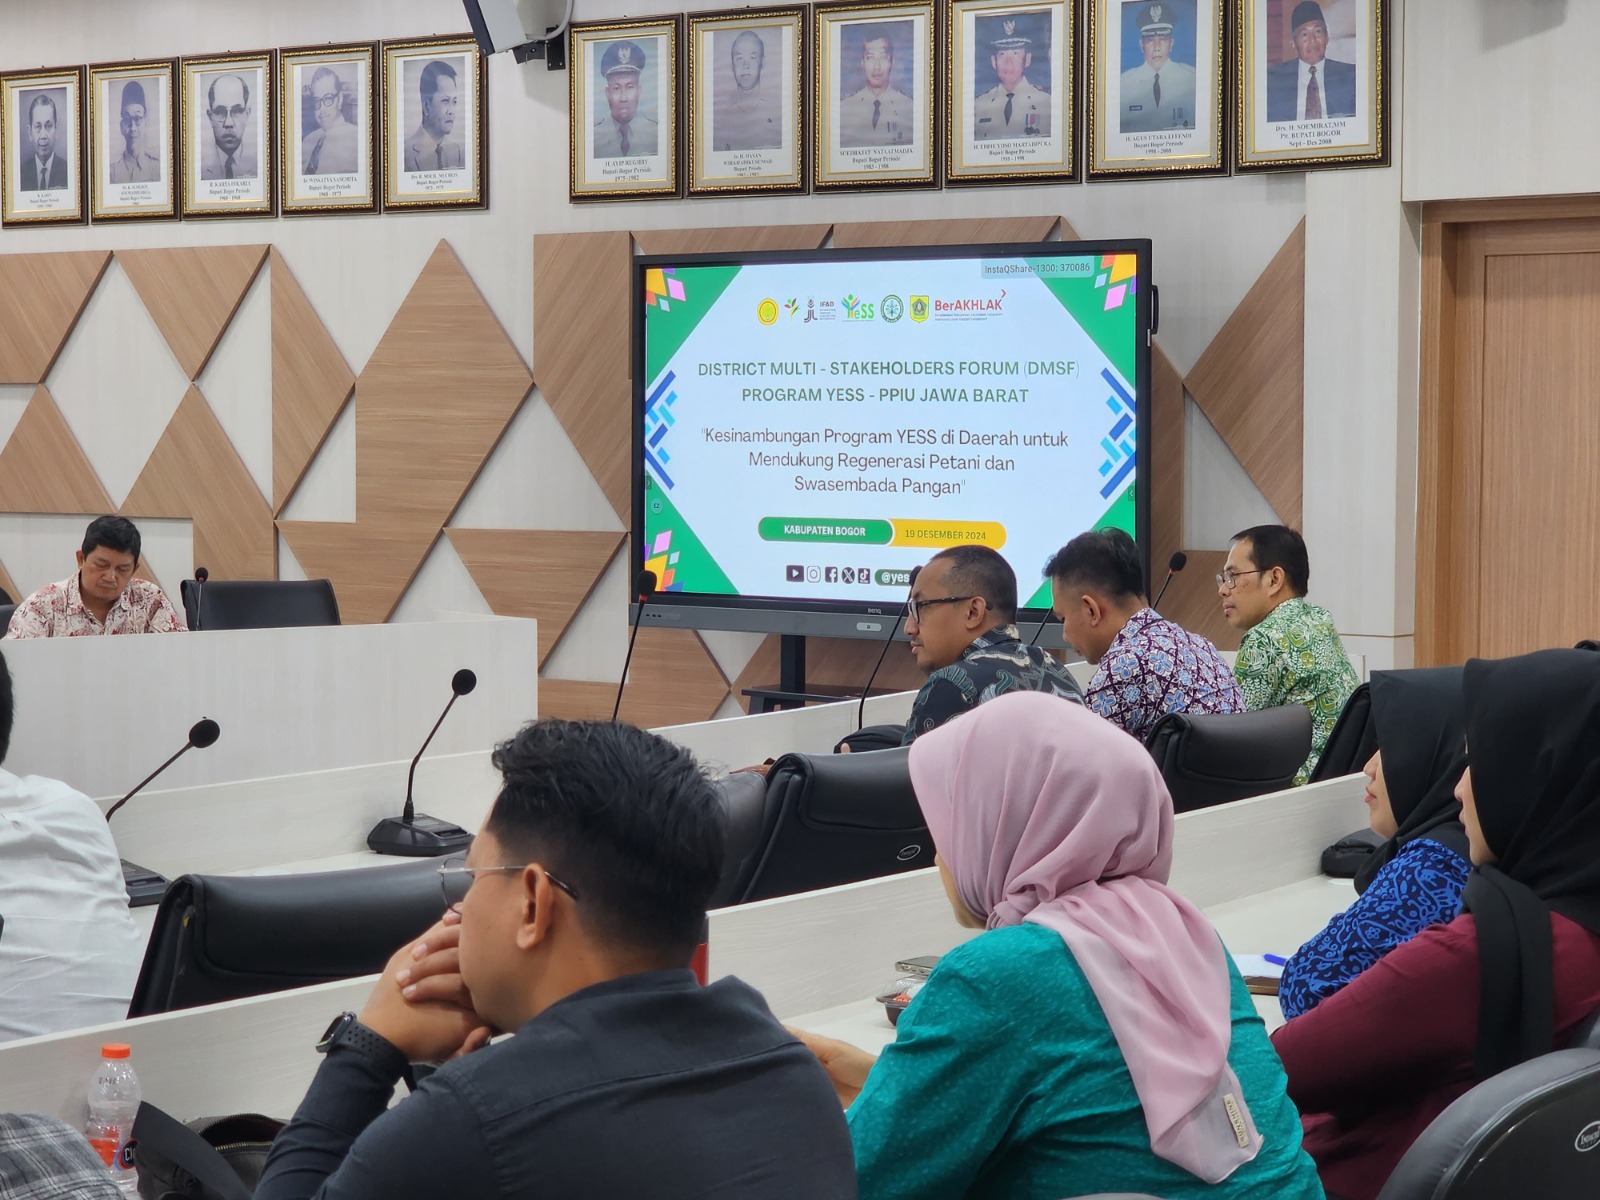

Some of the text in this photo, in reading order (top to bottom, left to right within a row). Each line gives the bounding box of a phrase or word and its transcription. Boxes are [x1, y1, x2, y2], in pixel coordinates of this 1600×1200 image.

[984, 263, 1090, 274] InstaQShare-1300: 370086
[934, 299, 1003, 311] BerAKHLAK
[698, 362, 766, 376] DISTRICT
[770, 362, 816, 375] MULTI
[830, 361, 955, 375] STAKEHOLDERS
[959, 361, 1019, 375] FORUM
[1023, 360, 1080, 378] (DMSF)
[742, 388, 822, 401] PROGRAM
[827, 388, 865, 401] YESS
[879, 388, 915, 402] PPIU
[920, 388, 968, 402] JAWA
[973, 389, 1029, 403] BARAT
[701, 427, 1069, 447] "Kesinambungan Program YESS di Daerah untuk
[749, 451, 1015, 472] Mendukung Regenerasi Petani dan
[794, 475, 966, 498] Swasembada Pangan"
[784, 524, 866, 537] KABUPATEN BOGOR
[905, 529, 986, 540] 19 DESEMBER 2024
